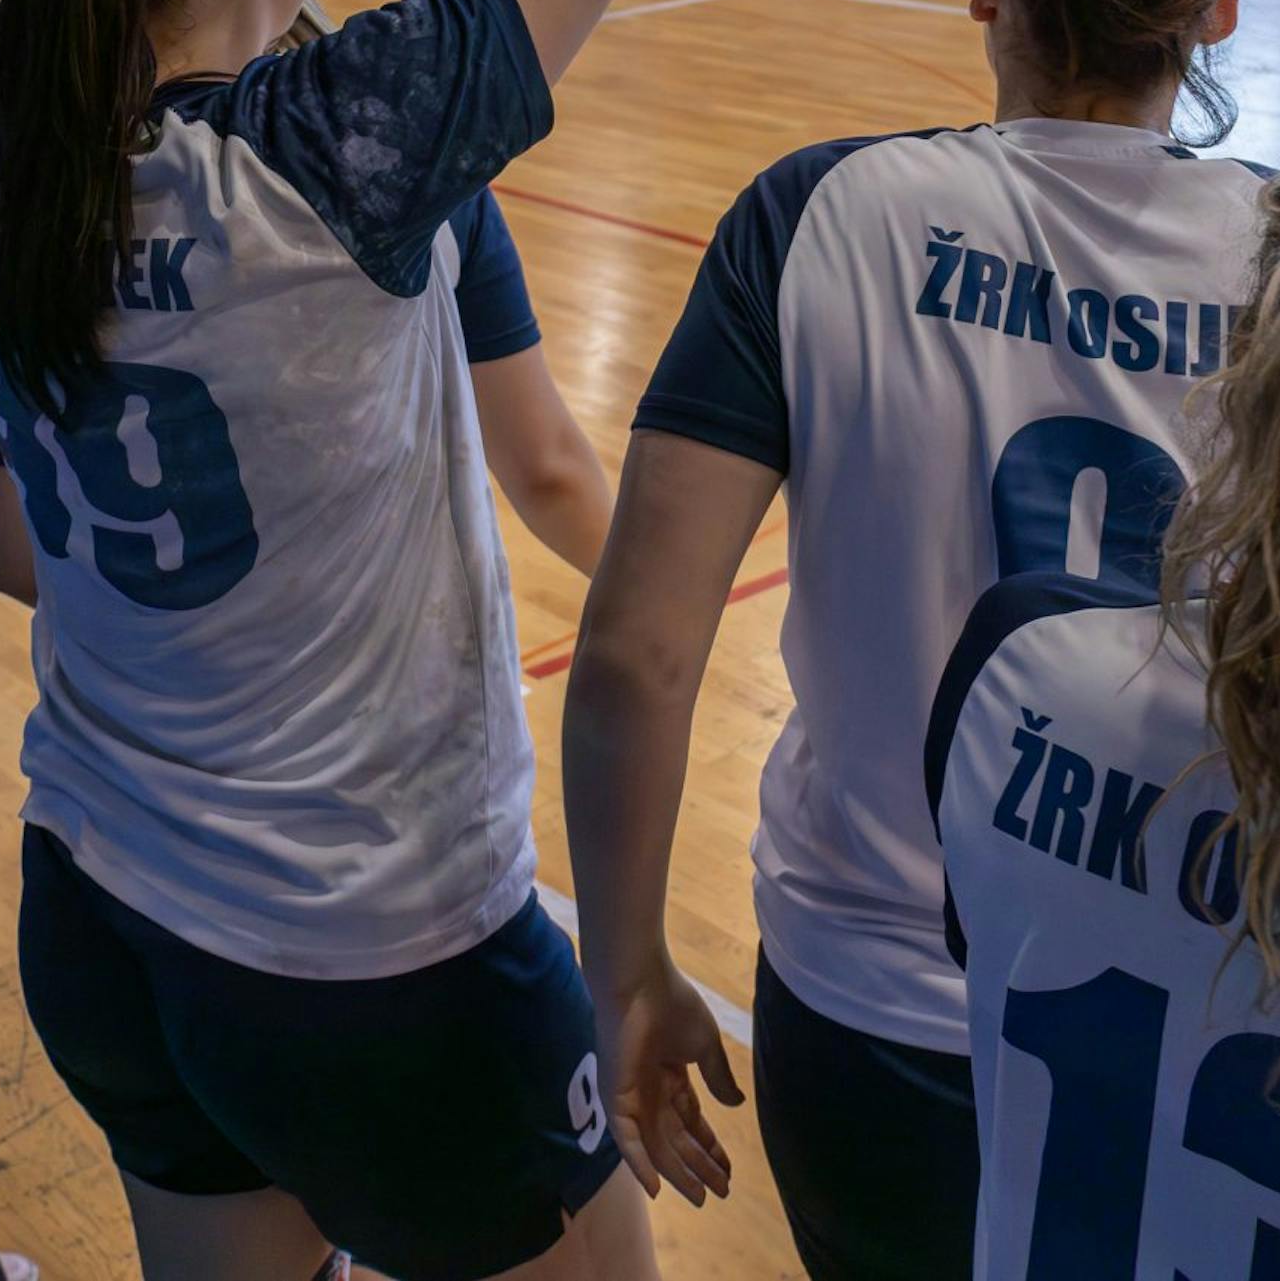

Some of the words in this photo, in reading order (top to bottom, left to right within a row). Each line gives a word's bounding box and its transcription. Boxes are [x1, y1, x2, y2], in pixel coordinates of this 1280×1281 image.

[916, 226, 1056, 345] ŽRK
[992, 707, 1165, 896] ŽRK
[567, 1051, 607, 1155] 9
